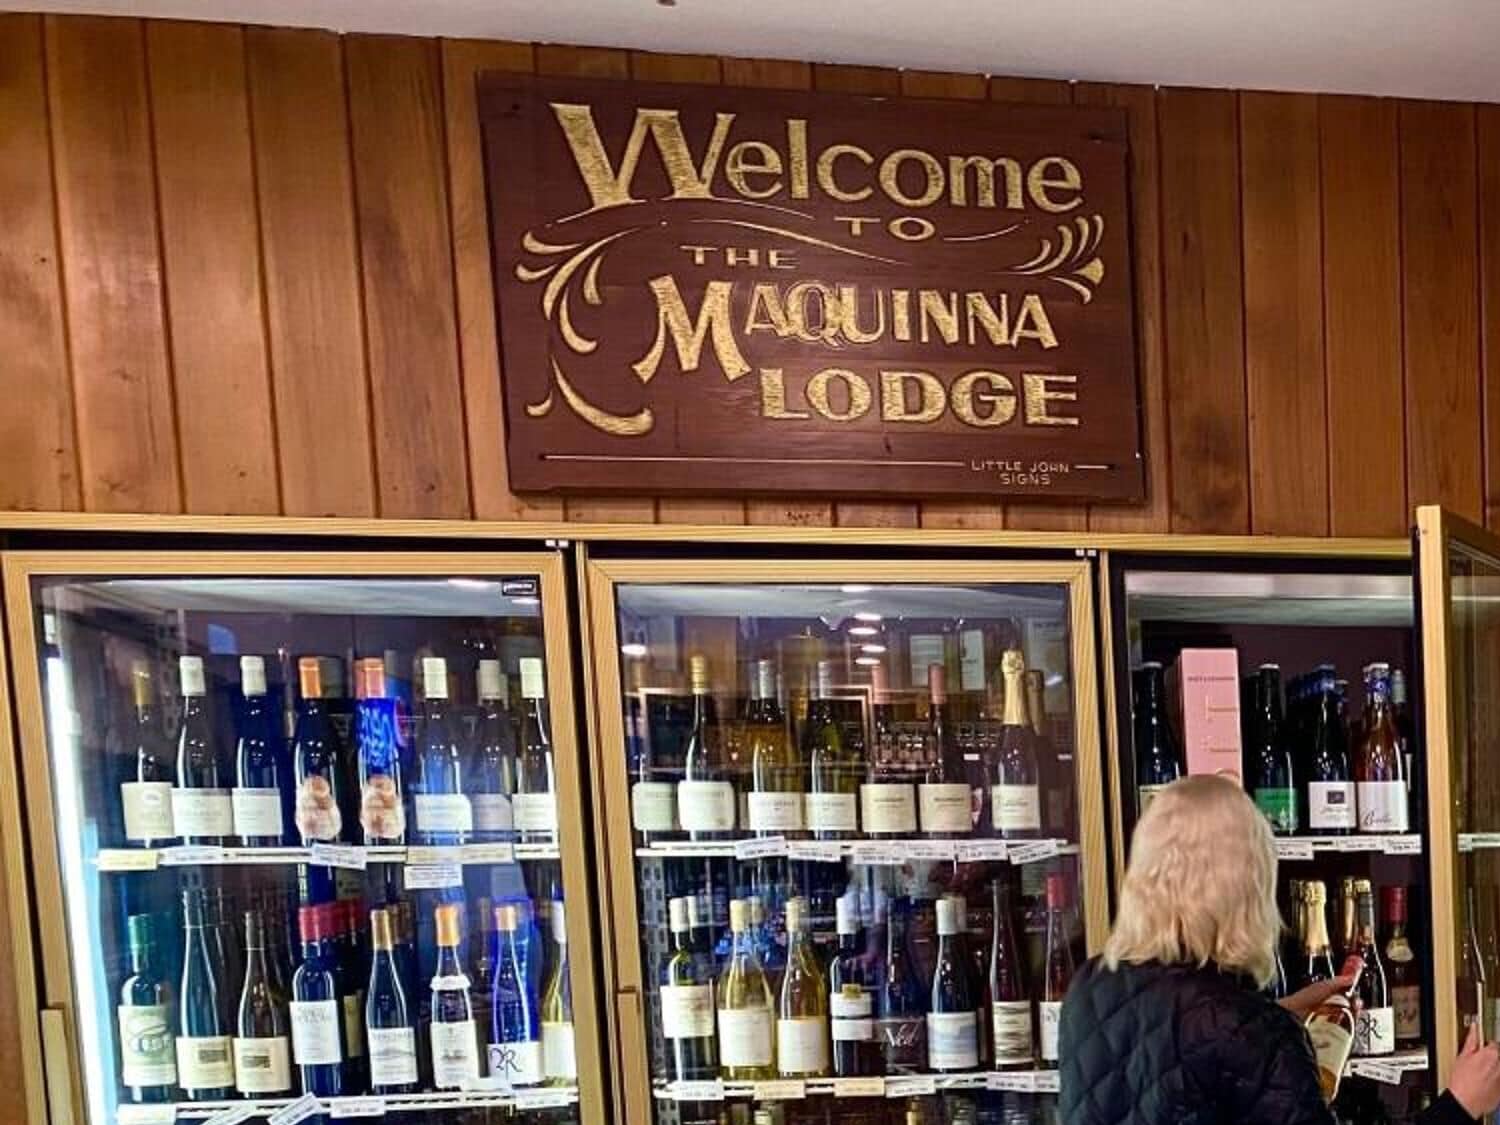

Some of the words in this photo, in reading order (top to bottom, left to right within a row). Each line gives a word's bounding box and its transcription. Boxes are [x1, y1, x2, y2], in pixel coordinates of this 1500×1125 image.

[549, 102, 1085, 213] Welcome
[834, 215, 936, 242] TO
[681, 245, 800, 270] THE
[631, 274, 1060, 383] MAQUINNA
[759, 366, 1081, 427] LODGE
[971, 459, 1022, 471] LITTLE
[1029, 461, 1069, 473] JOHN
[1000, 473, 1051, 485] SIGNS
